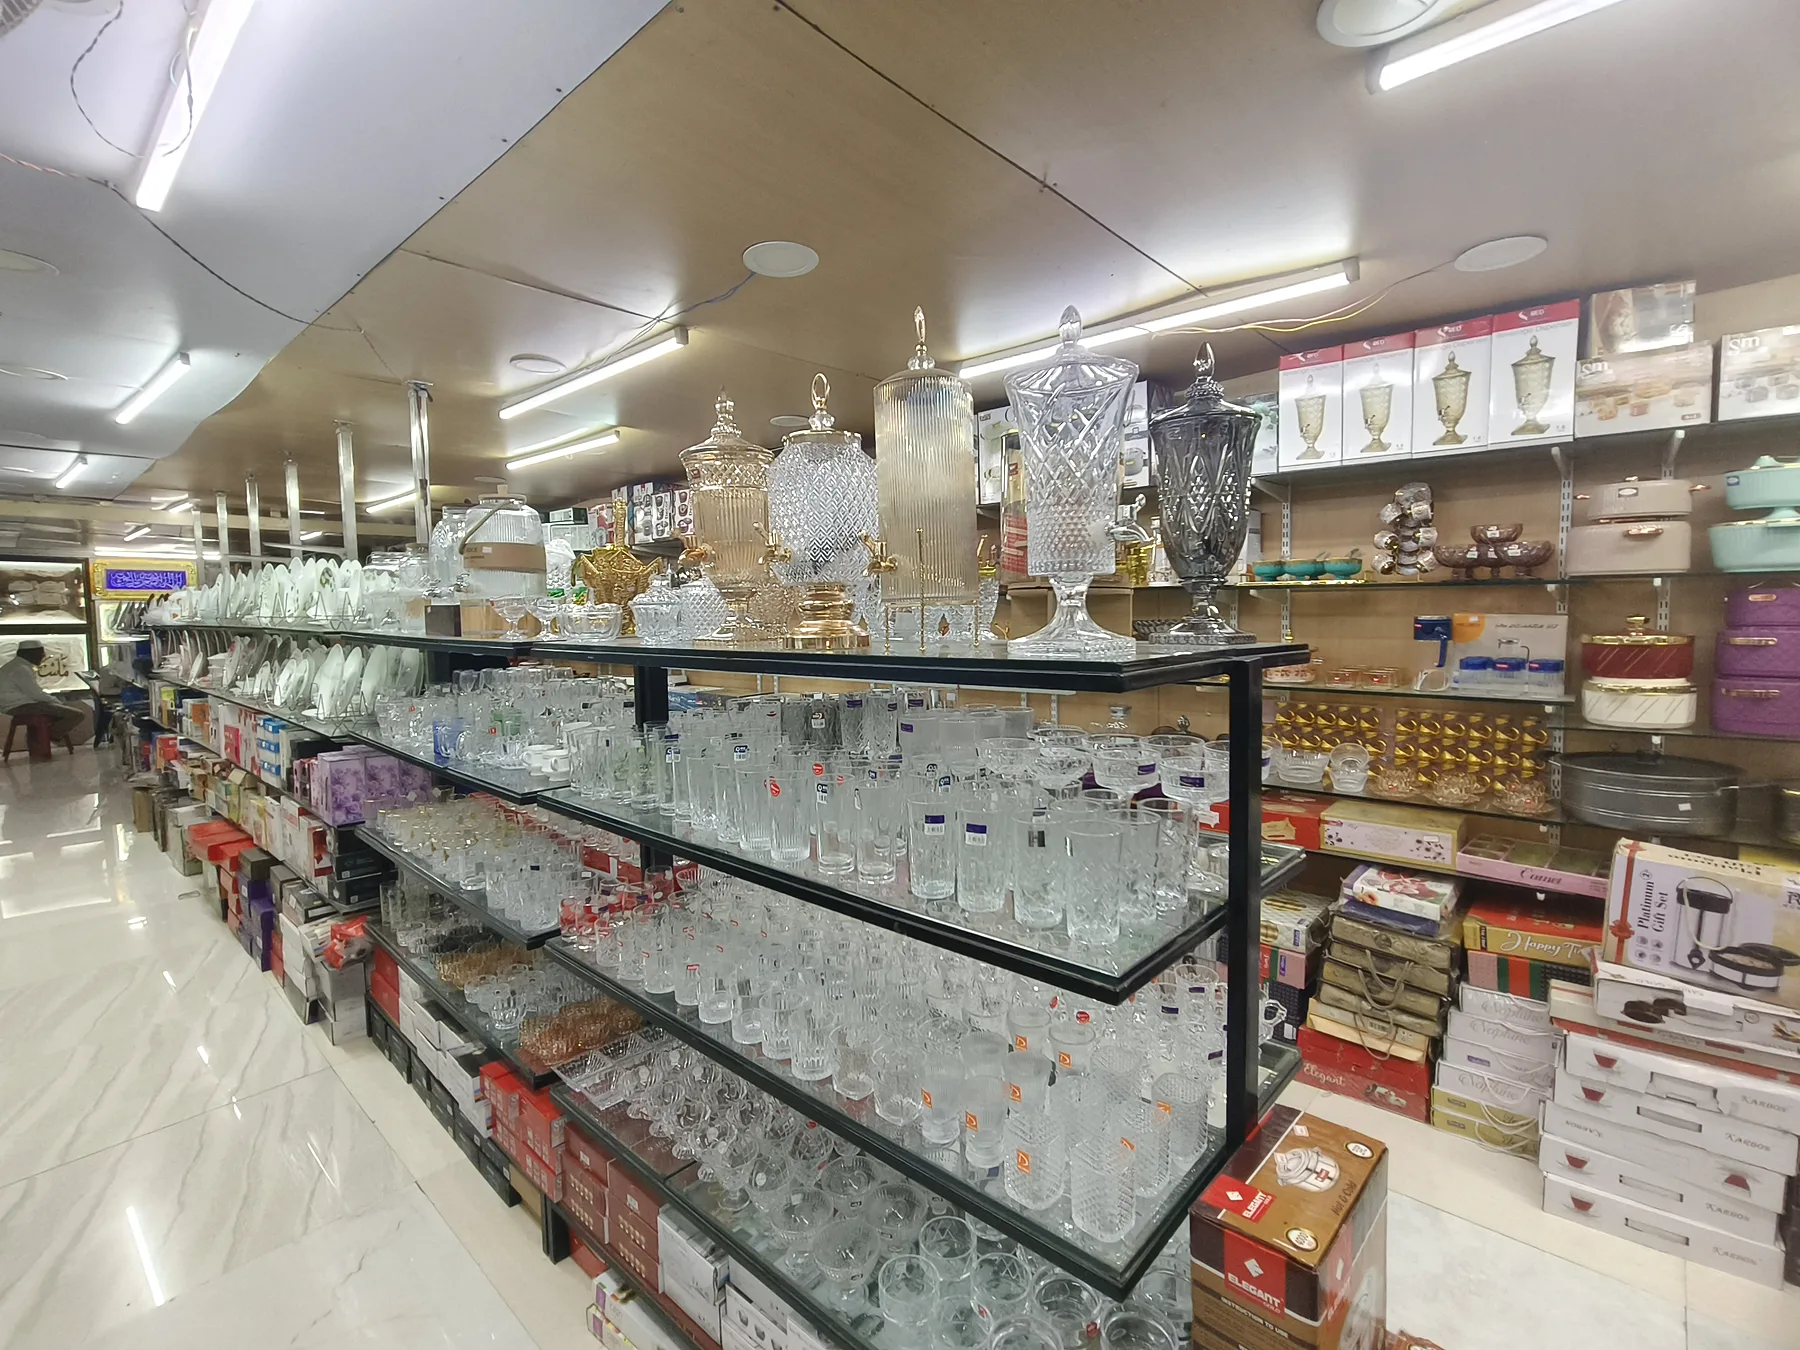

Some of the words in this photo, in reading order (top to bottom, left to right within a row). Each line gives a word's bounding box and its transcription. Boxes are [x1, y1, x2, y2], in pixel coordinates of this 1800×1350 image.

[1637, 881, 1654, 929] Platinum
[1657, 892, 1668, 910] Set
[1652, 912, 1665, 933] Gift
[1500, 931, 1561, 955] Happy
[1303, 1062, 1346, 1086] Elegant
[1242, 1190, 1268, 1219] ELEGANT
[1228, 1273, 1280, 1307] ELEGANT
